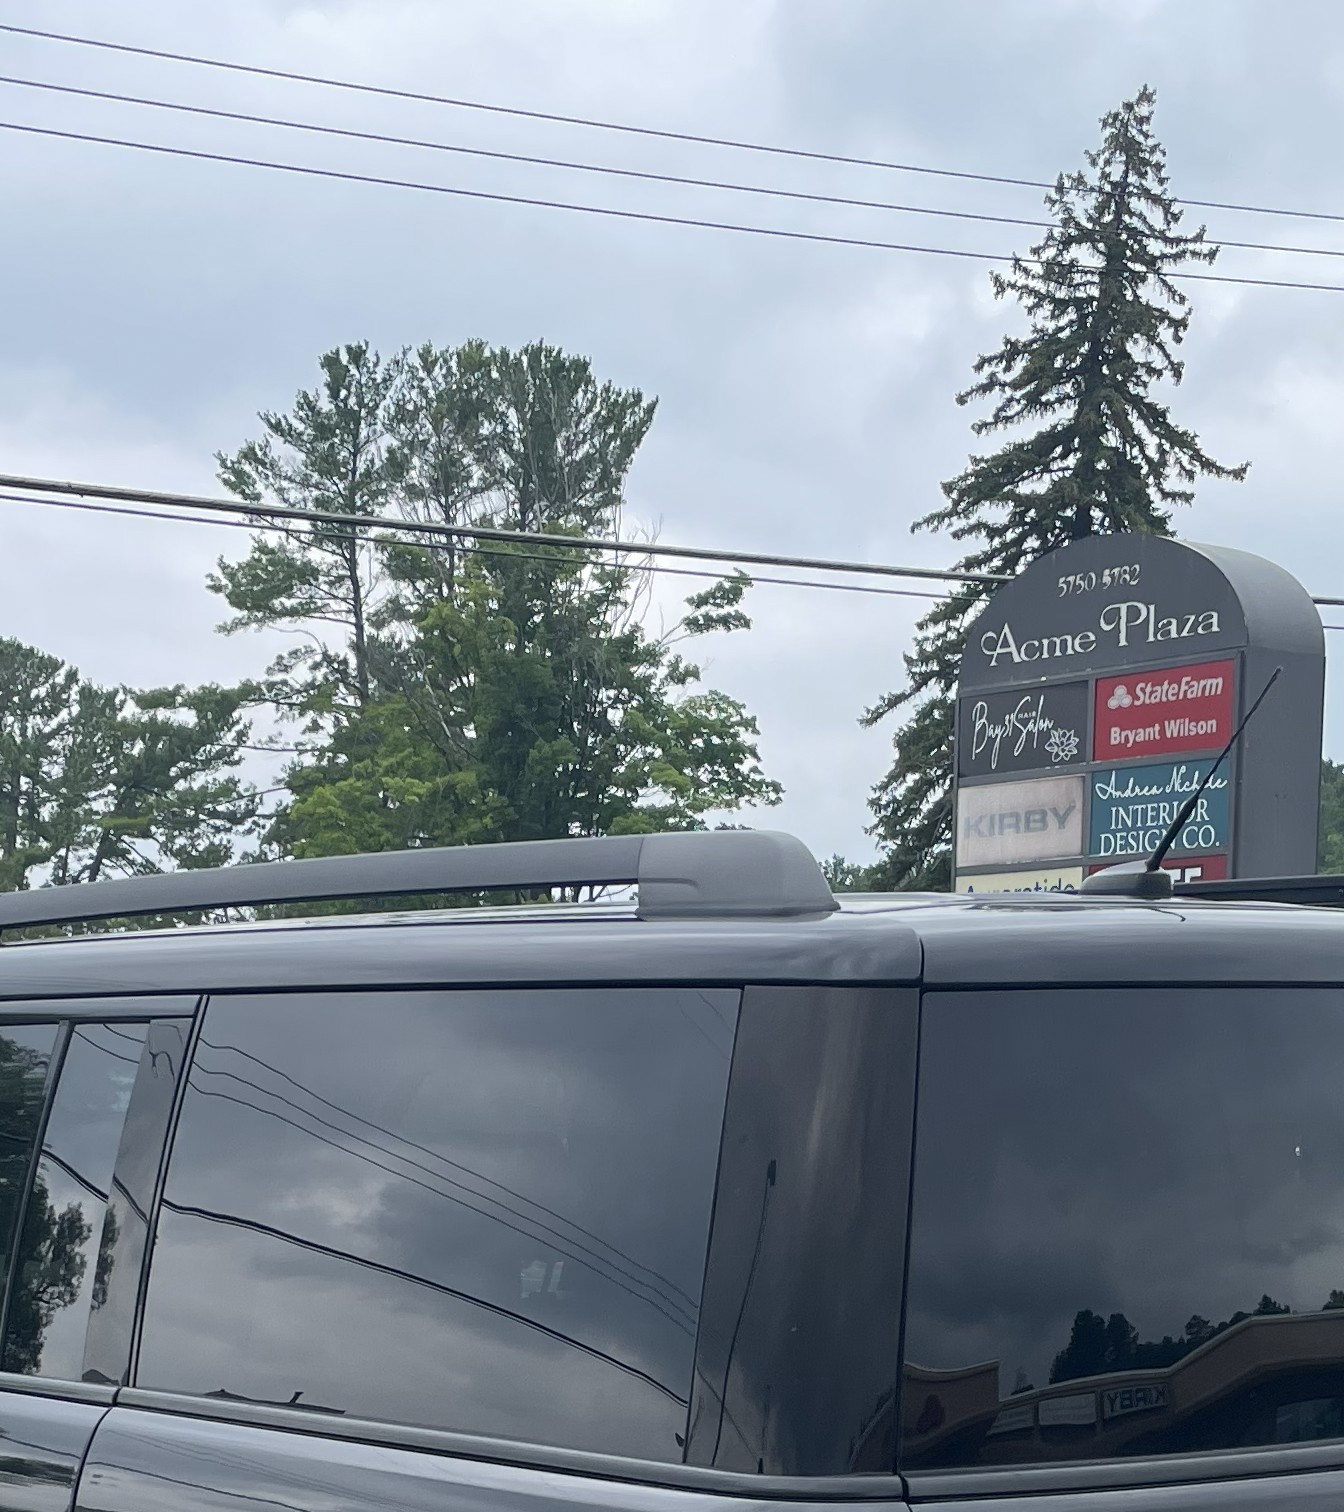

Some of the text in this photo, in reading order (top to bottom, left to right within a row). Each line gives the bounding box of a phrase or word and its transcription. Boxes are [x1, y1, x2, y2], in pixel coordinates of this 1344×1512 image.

[1058, 564, 1141, 598] 5750 5782
[980, 601, 1221, 667] Acme Plaza
[1110, 717, 1217, 748] Bryant Wilson
[1095, 765, 1228, 800] Andrea Nichle
[963, 802, 1076, 840] KIRBY
[1182, 824, 1220, 849] CO.
